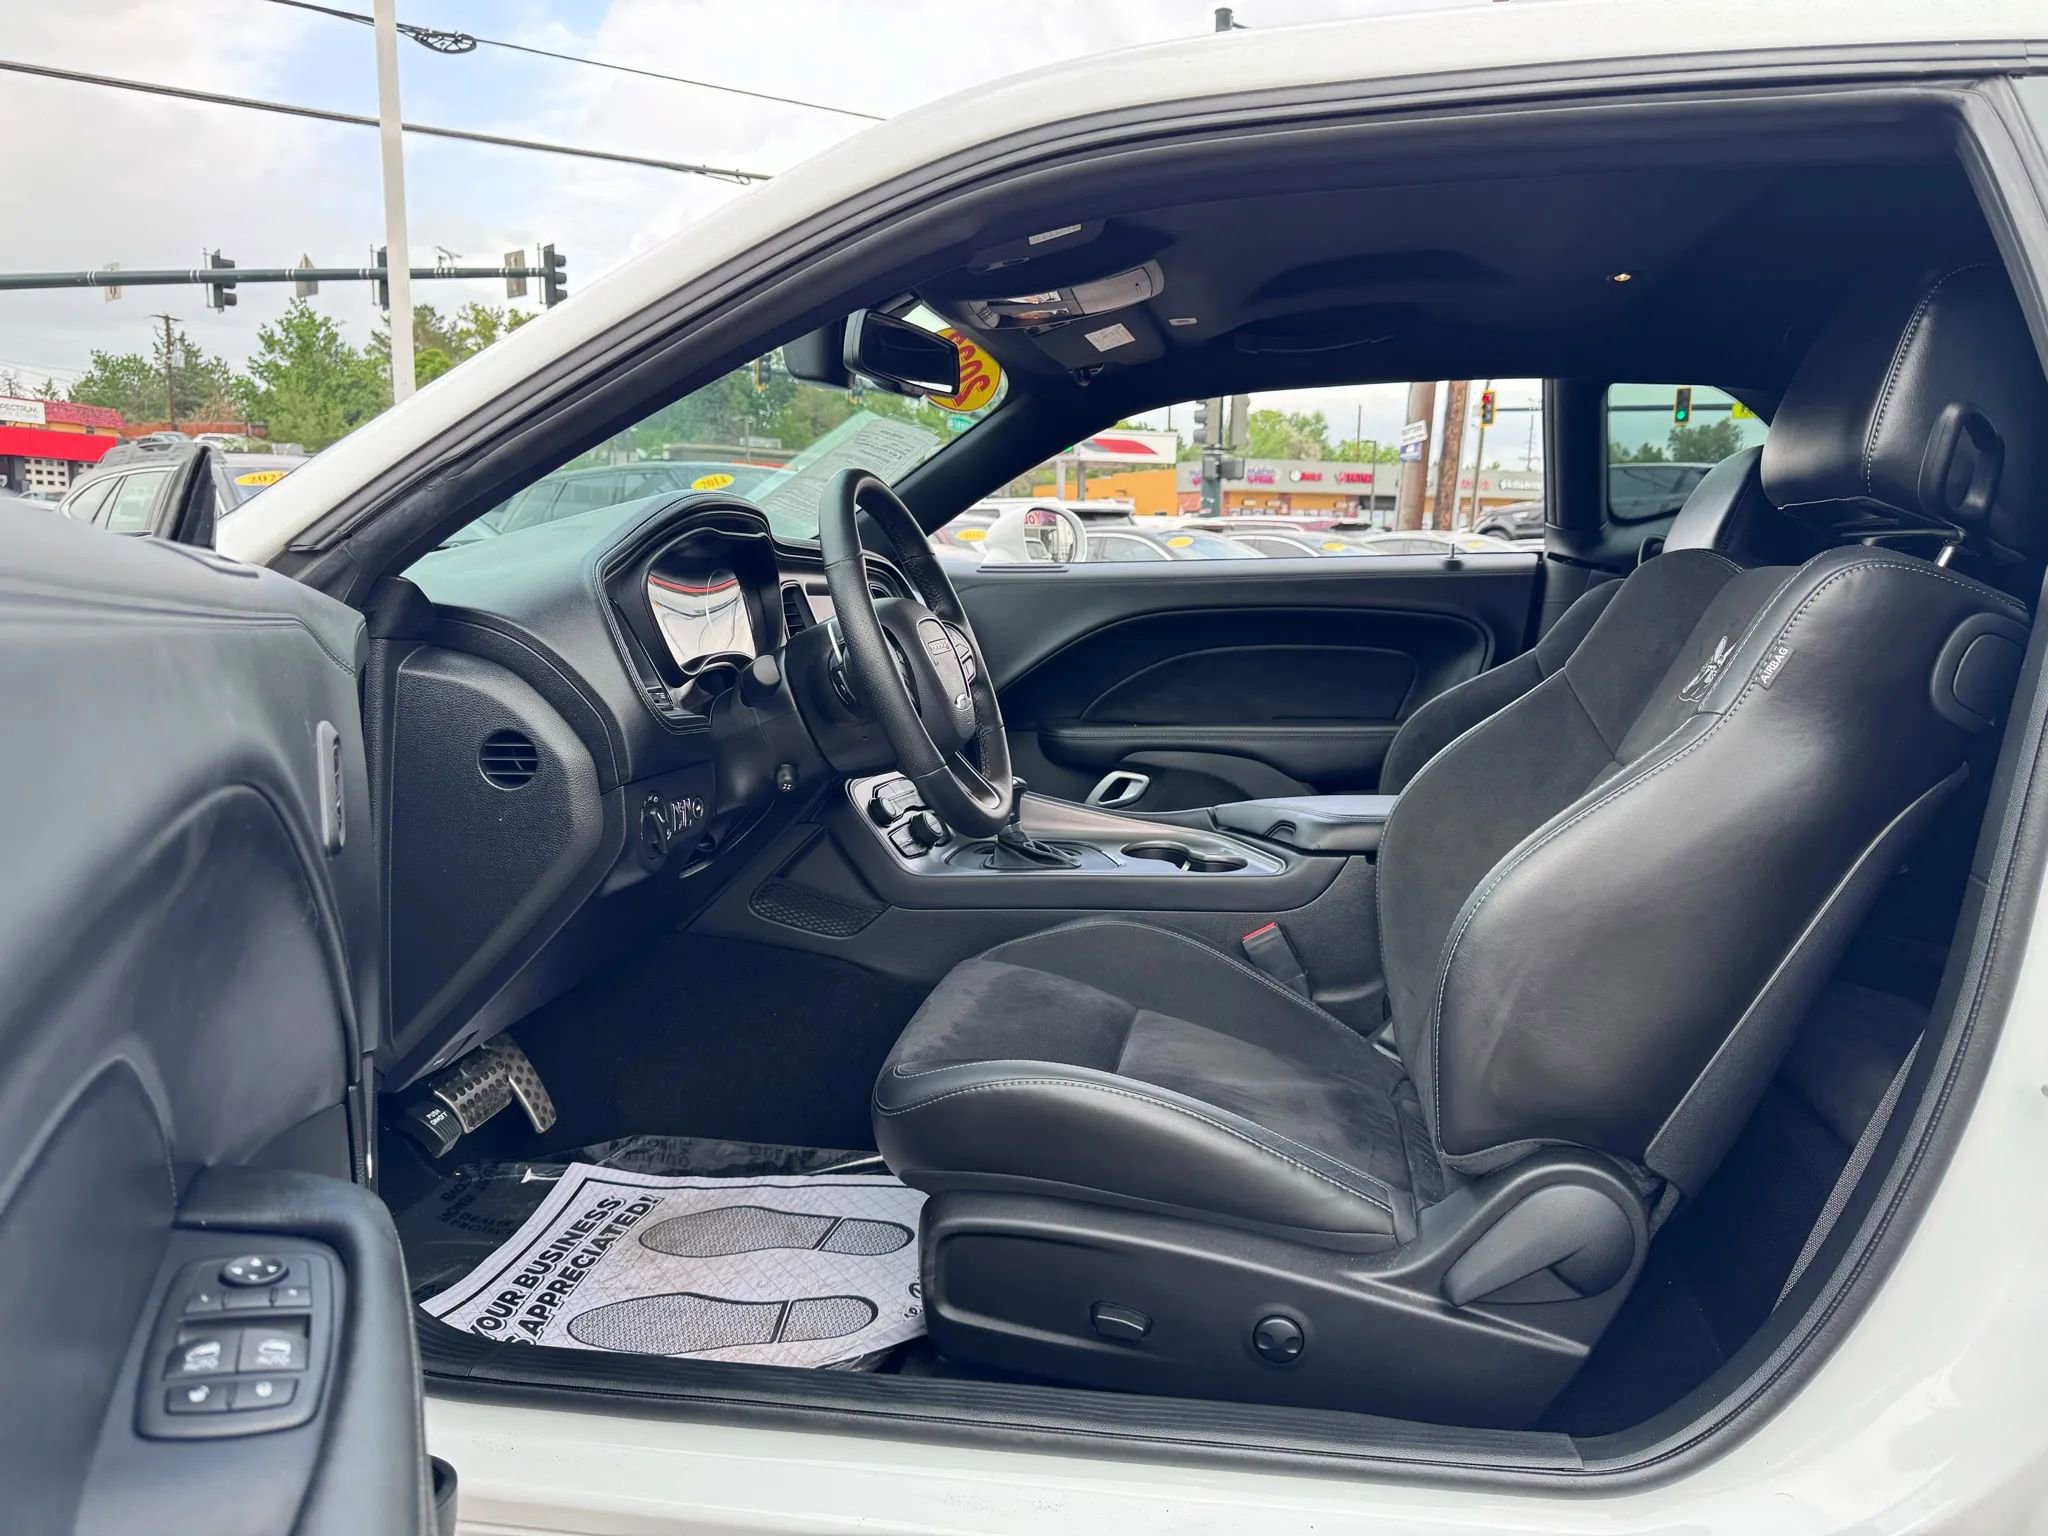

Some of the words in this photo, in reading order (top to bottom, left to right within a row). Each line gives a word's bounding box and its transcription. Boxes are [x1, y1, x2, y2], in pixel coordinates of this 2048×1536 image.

[1760, 647, 1789, 684] AIRBAG
[512, 1197, 623, 1290] BUSINESS
[517, 1194, 662, 1338] APPRECIATED!
